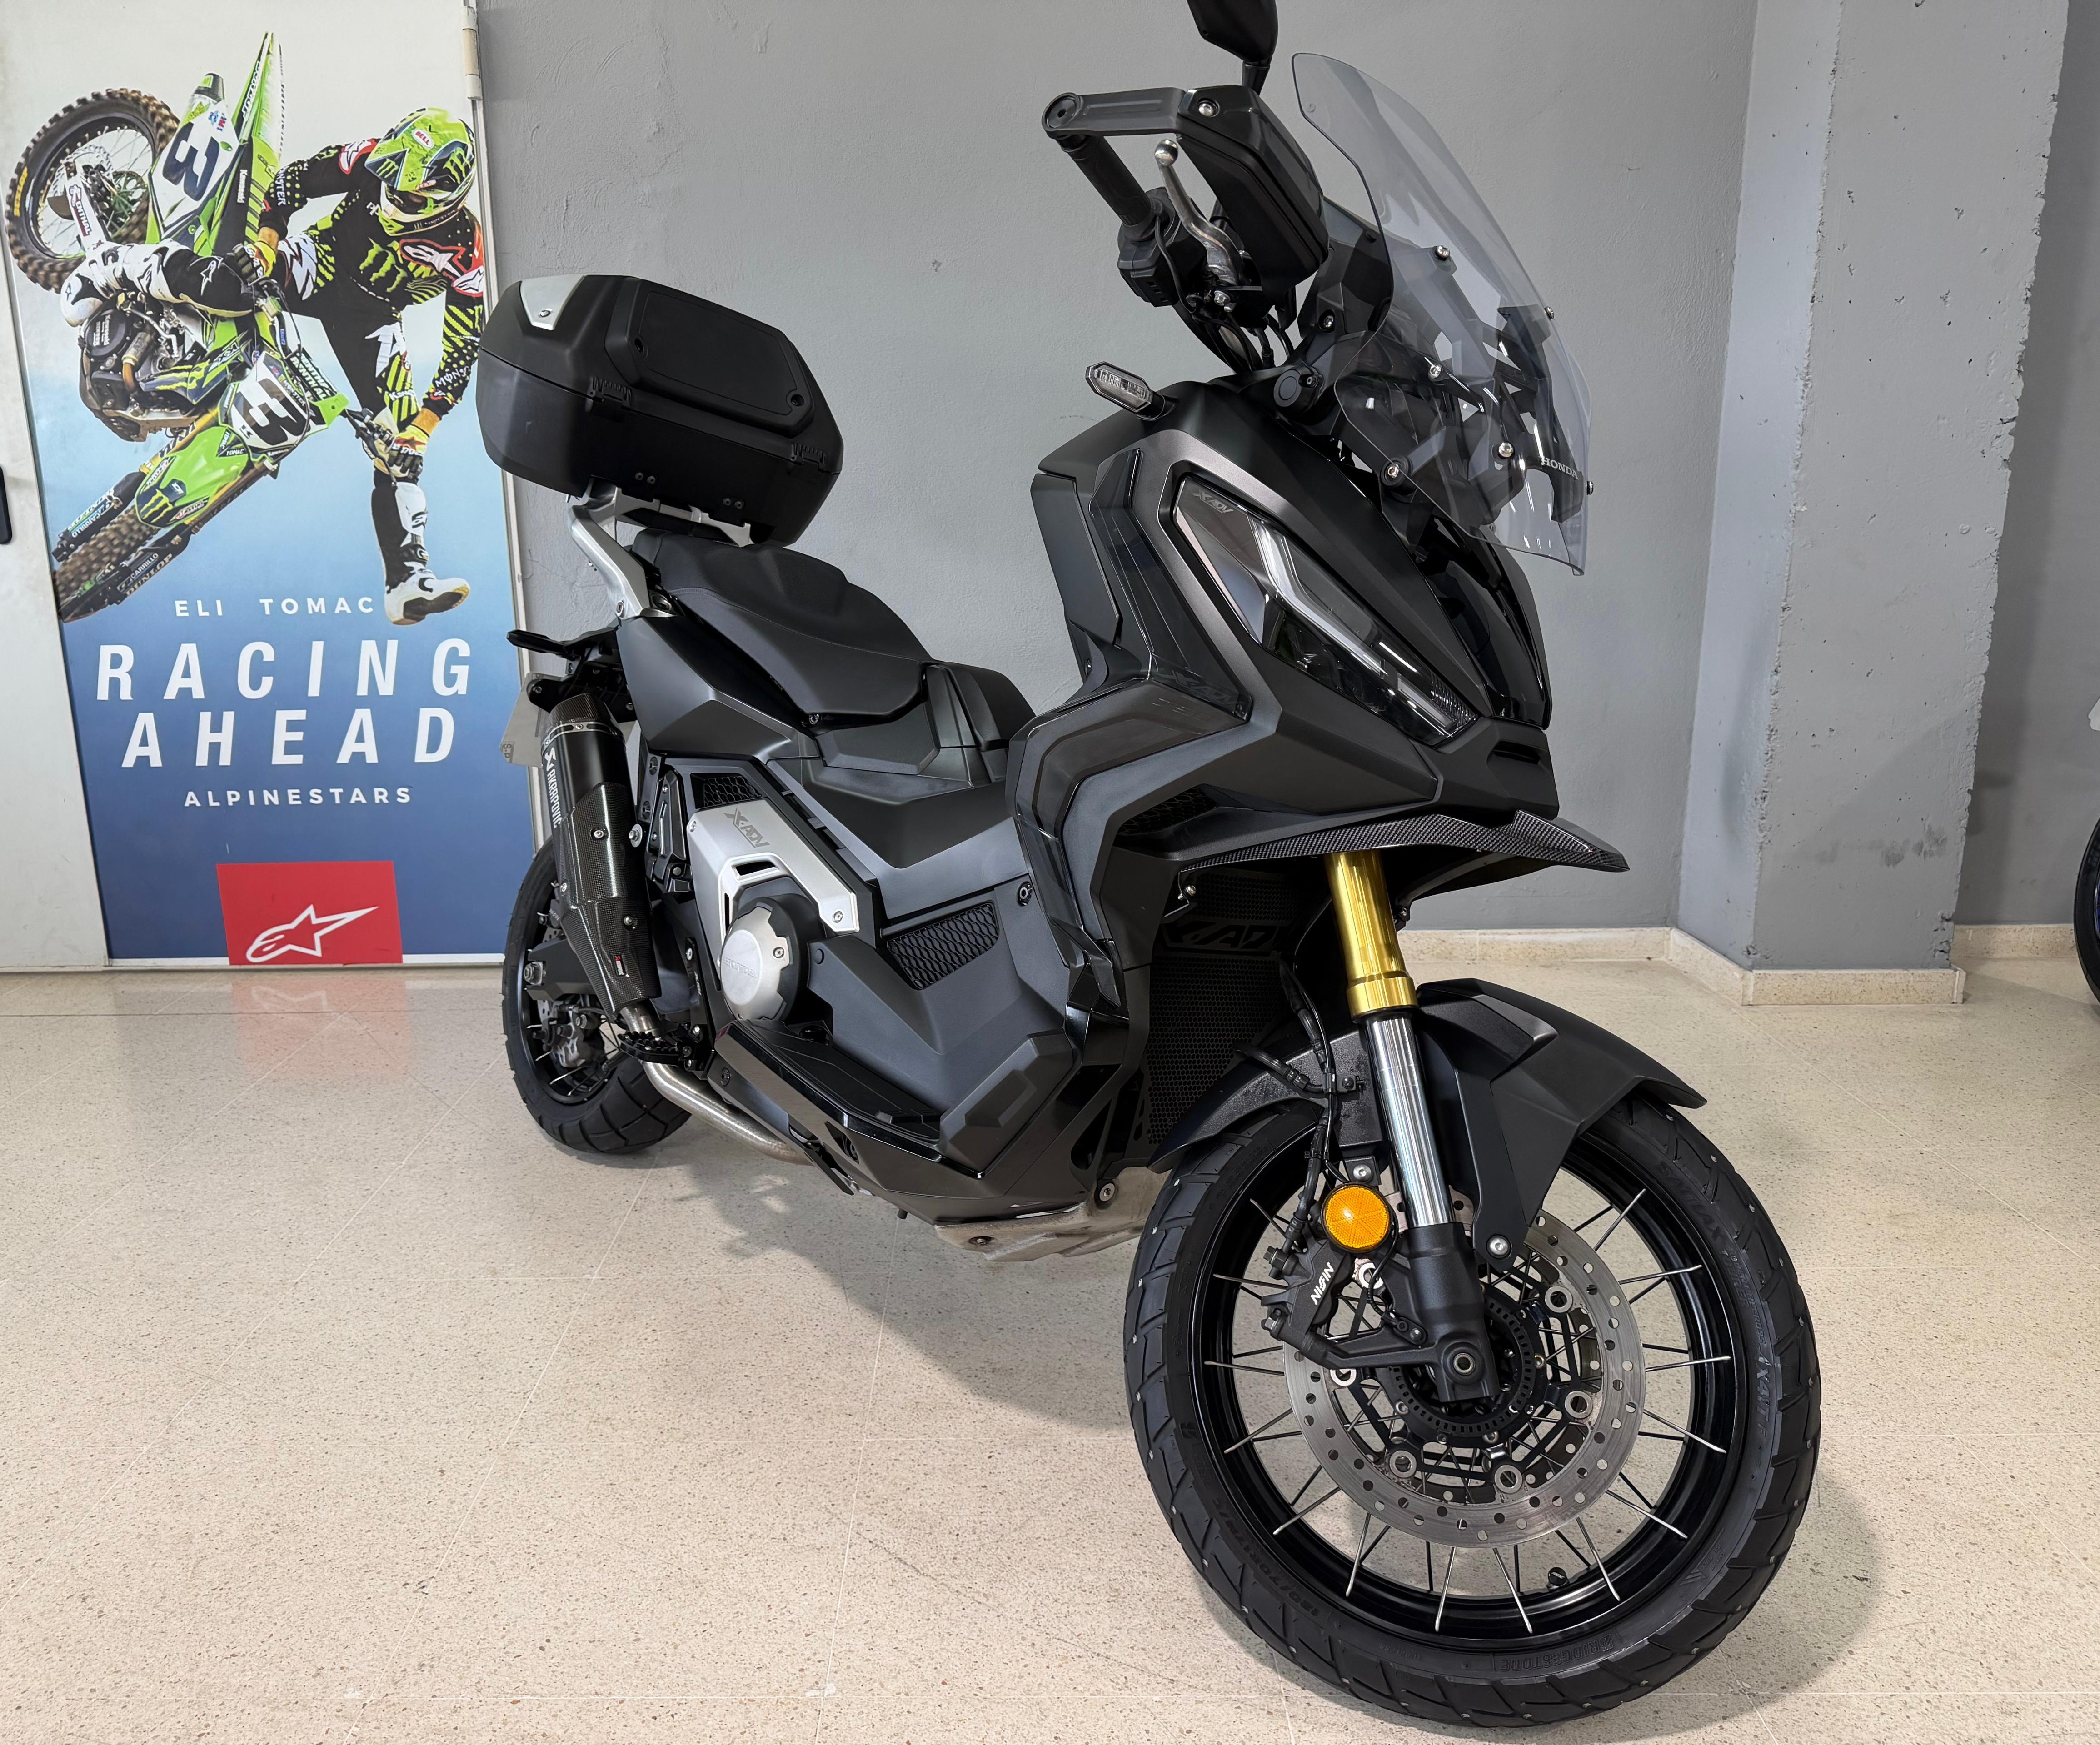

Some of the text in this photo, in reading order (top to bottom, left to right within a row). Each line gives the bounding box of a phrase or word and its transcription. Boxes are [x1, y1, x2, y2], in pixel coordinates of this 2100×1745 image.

[414, 130, 430, 145] BELL
[234, 379, 311, 446] 3
[1539, 456, 1579, 480] HONDA
[125, 553, 173, 597] DUNLOP
[130, 553, 159, 579] CARRILLO
[175, 597, 374, 617] ELI TOMAC
[97, 638, 471, 700] RACING
[121, 708, 455, 768] AHEAD
[184, 787, 411, 807] ALPINESTARS
[724, 956, 757, 978] HONDA
[1311, 1261, 1334, 1305] NISSIN
[1501, 1634, 1613, 1672] BRIDGESTONE
